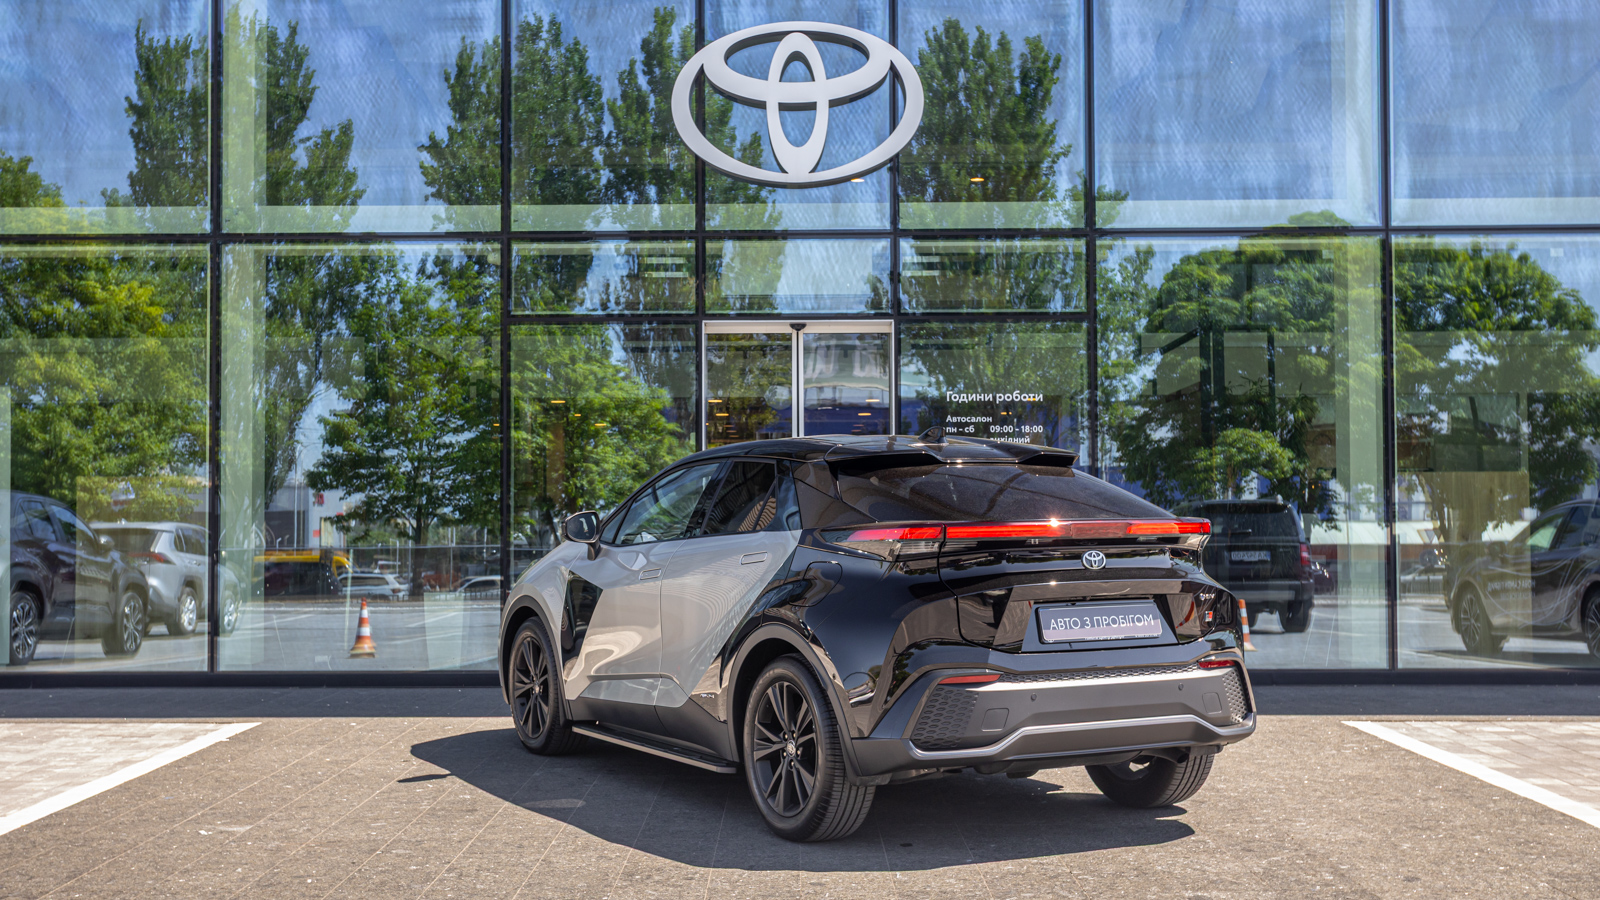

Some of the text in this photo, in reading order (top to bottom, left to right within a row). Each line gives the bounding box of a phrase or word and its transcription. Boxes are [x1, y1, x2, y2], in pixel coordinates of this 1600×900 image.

[946, 390, 1043, 404] Години роботи
[945, 415, 993, 423] Автосалон
[964, 425, 975, 433] сб
[989, 425, 1014, 433] 09:00
[1021, 425, 1043, 433] 18:00
[1050, 617, 1080, 631] АВТО
[1093, 613, 1154, 628] ПРОБІГОМ
